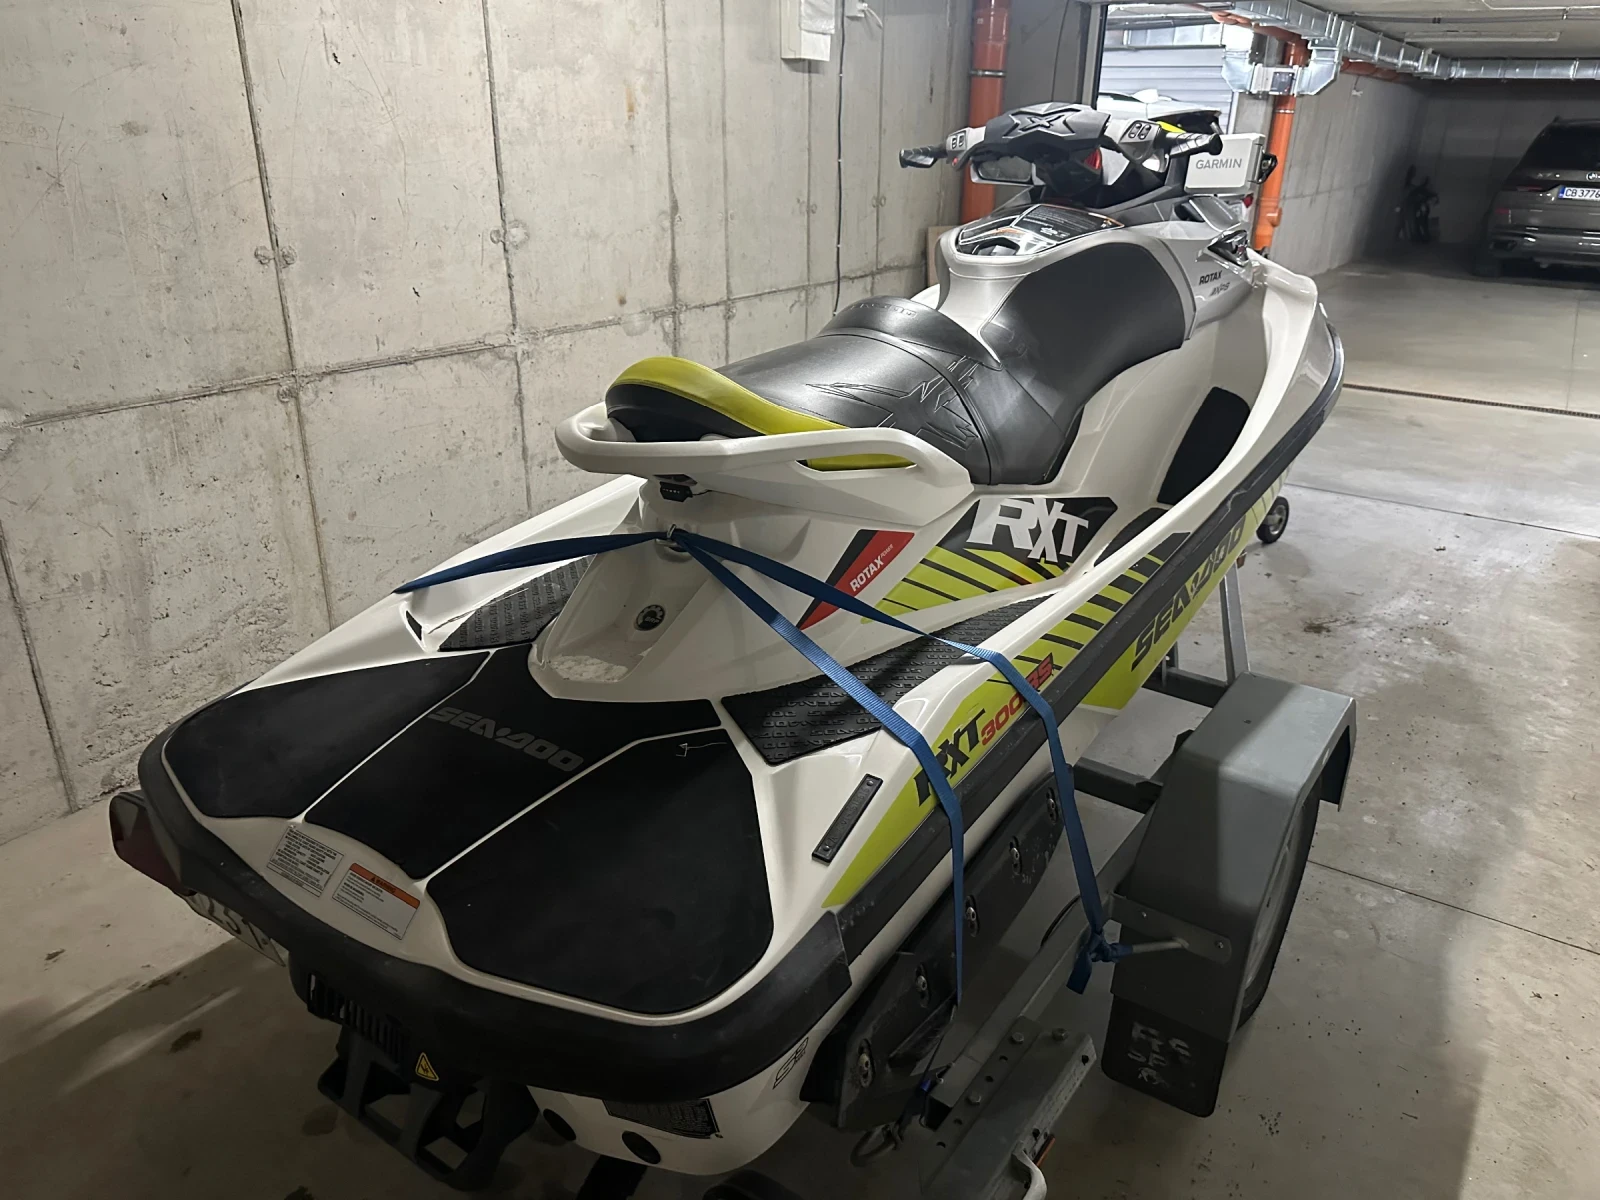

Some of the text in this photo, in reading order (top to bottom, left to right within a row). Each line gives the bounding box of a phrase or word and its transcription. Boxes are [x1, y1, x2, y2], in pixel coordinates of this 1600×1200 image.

[1195, 158, 1242, 170] GARMIN
[1565, 188, 1578, 198] CB
[1198, 270, 1223, 286] ROTAX
[966, 497, 1089, 563] RXT
[849, 555, 885, 592] ROTAX
[980, 693, 1025, 746] 300
